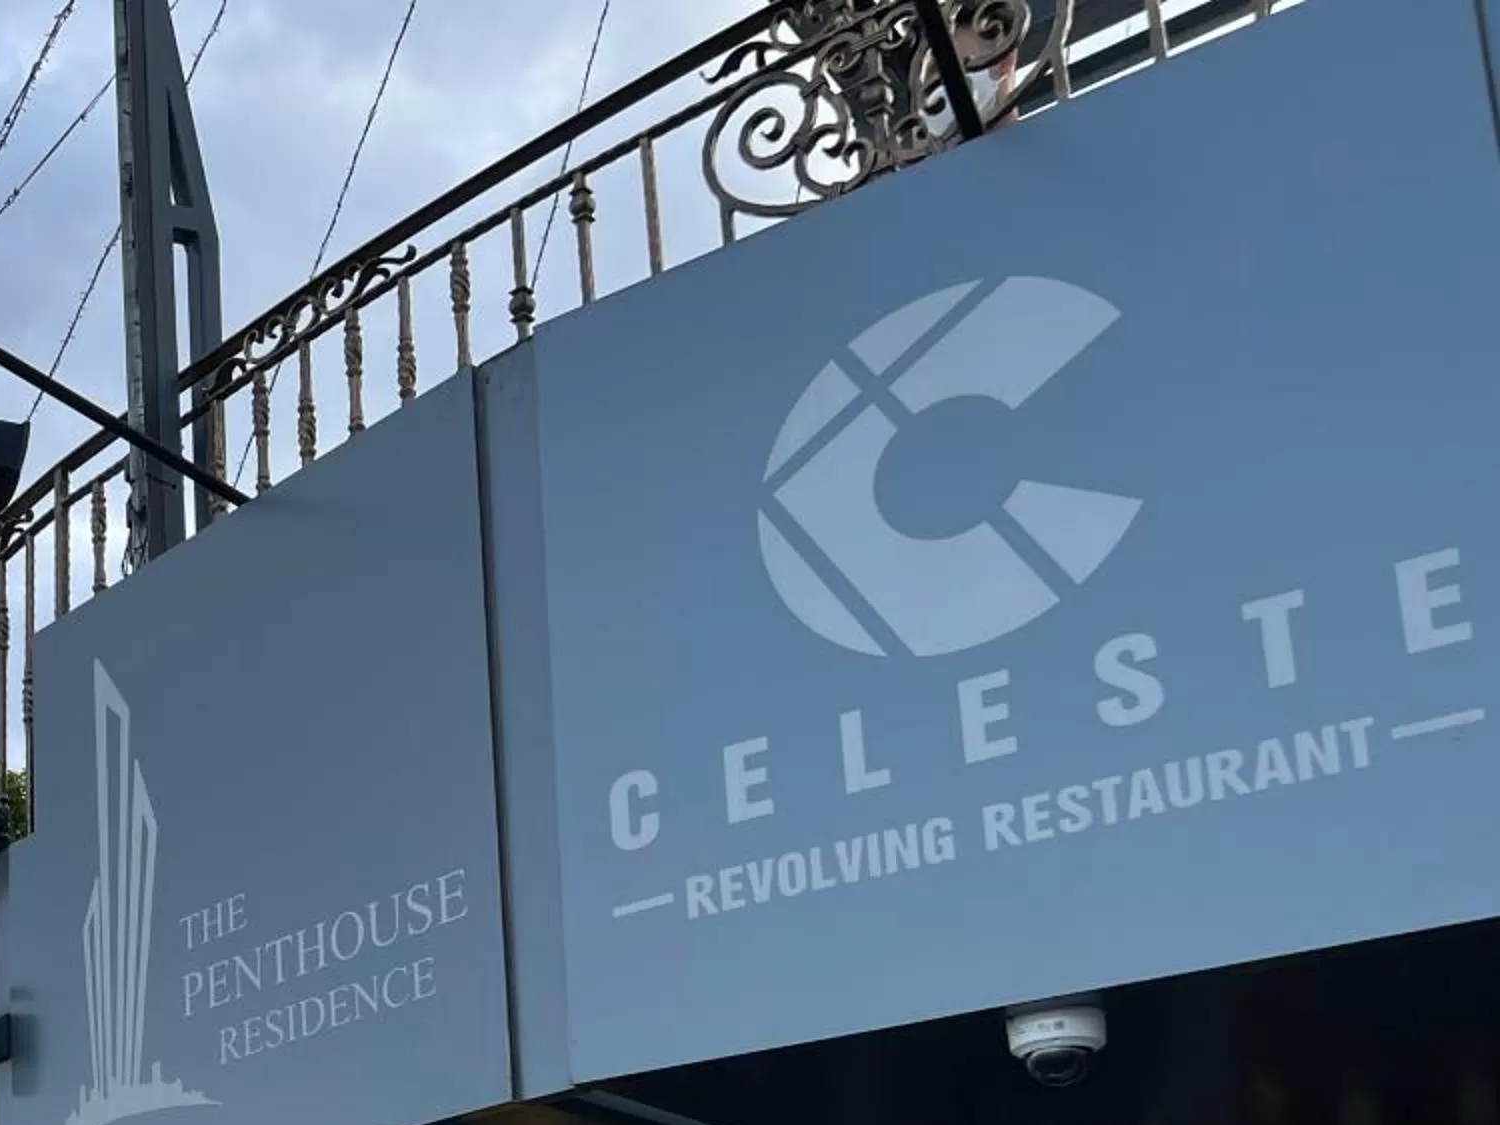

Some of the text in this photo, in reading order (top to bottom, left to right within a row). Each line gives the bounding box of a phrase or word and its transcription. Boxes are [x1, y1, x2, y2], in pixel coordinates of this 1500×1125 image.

[609, 548, 1473, 851] CELESTE
[685, 717, 1375, 919] REVOLVING RESTAURANT
[179, 893, 248, 949] THE
[181, 868, 469, 1017] PENTHOUSE
[216, 956, 437, 1065] RESIDENCE
